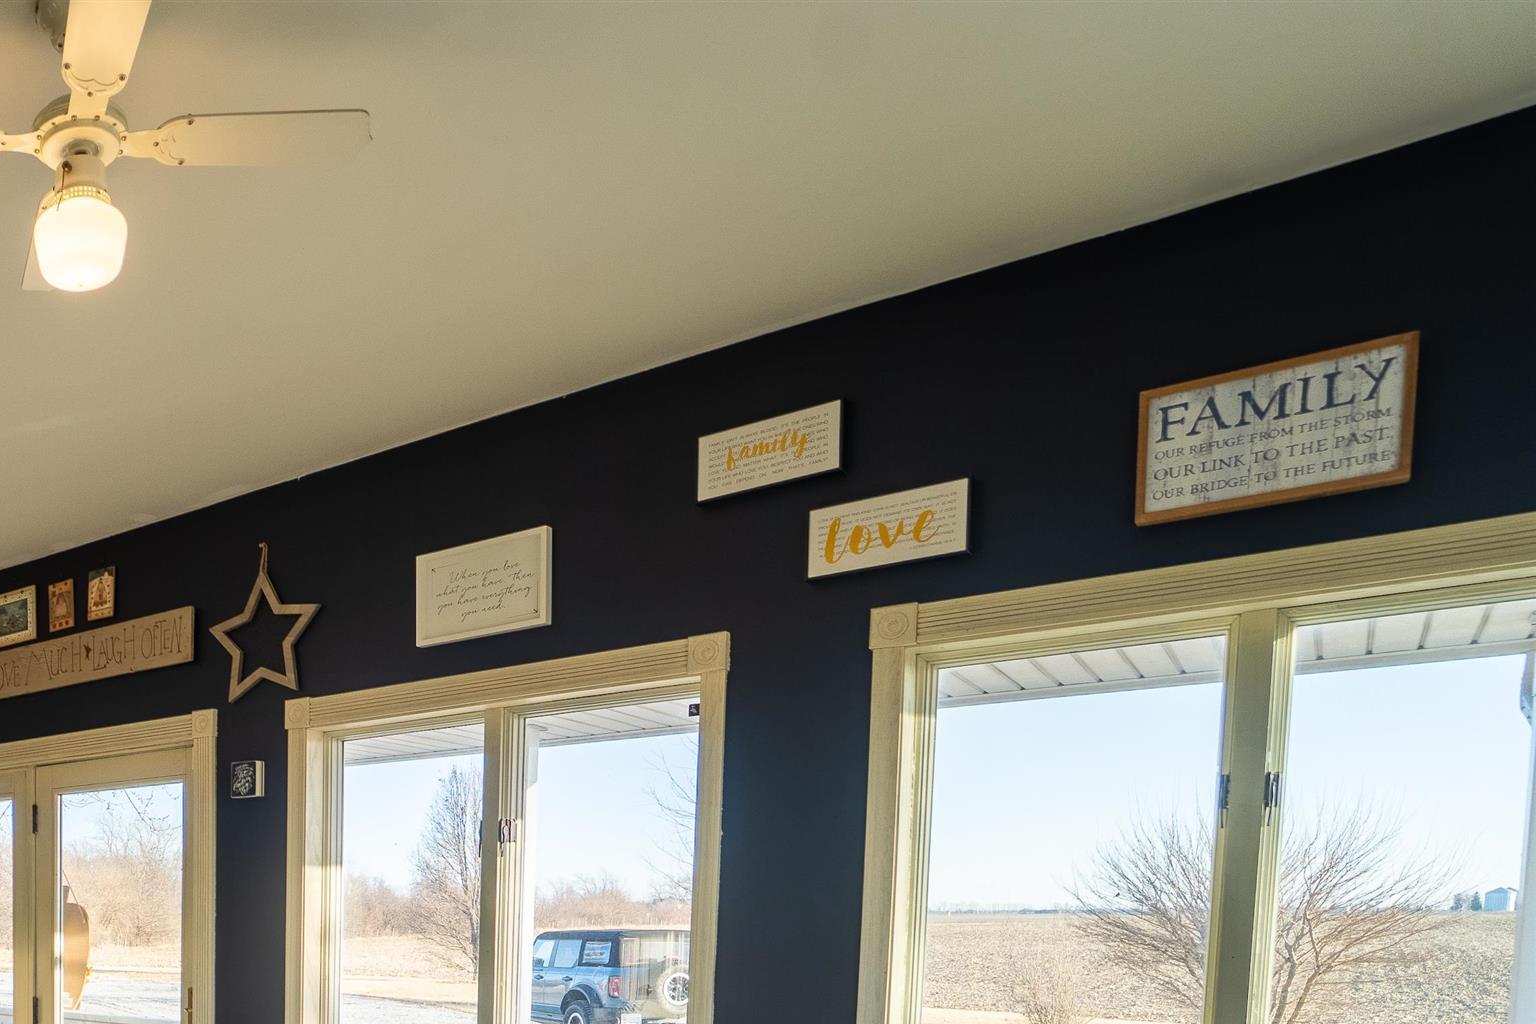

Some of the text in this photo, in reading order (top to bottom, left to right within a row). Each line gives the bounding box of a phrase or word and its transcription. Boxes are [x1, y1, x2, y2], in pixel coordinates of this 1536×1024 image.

[1155, 357, 1398, 444] FAMILY
[1154, 407, 1394, 461] OUR REFUGE FROM THE STORM
[1154, 464, 1196, 481] OUR
[1200, 454, 1246, 474] LINK
[1251, 448, 1280, 464] TO
[1286, 438, 1329, 458] THE
[1152, 487, 1185, 501] OUR
[1190, 475, 1249, 495] BRIDGE
[1254, 471, 1278, 484] TO
[1283, 463, 1316, 478] THE
[825, 510, 942, 564] love
[436, 584, 460, 598] what
[460, 585, 479, 600] you
[449, 560, 520, 584] When you love
[437, 583, 533, 616] you have everything
[461, 610, 477, 623] you
[24, 635, 82, 686] MUCH
[90, 624, 136, 671] LAUGH
[141, 615, 183, 660] OFTEN
